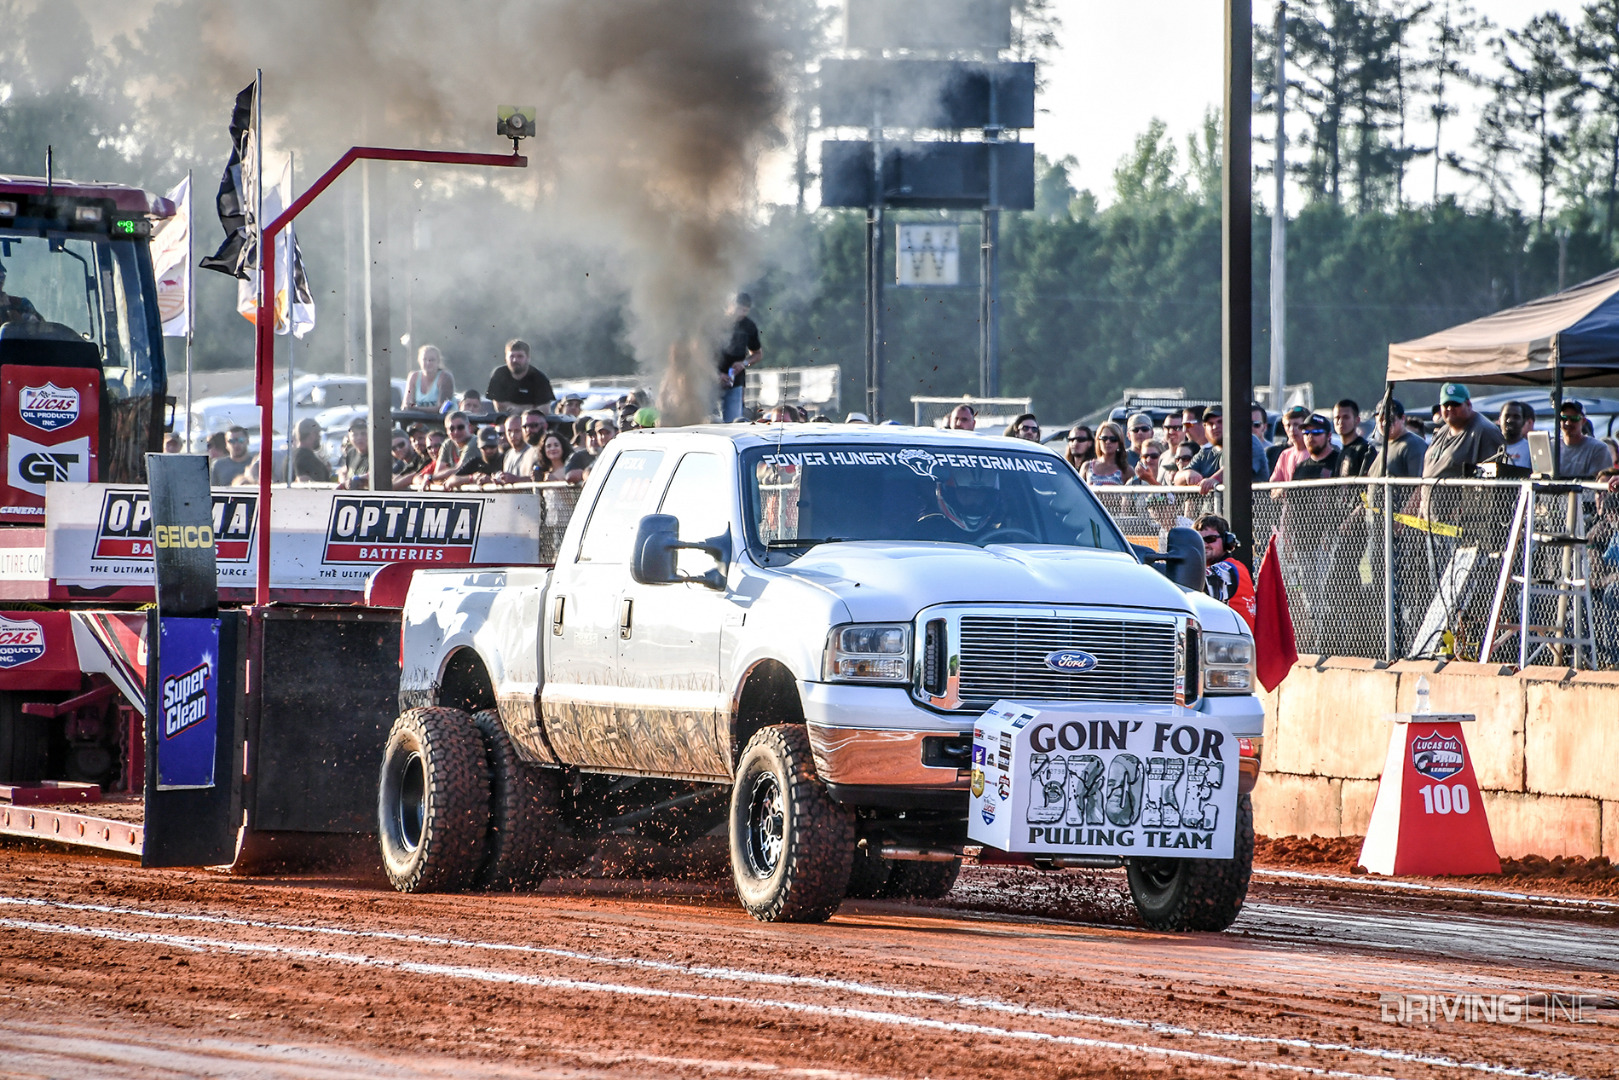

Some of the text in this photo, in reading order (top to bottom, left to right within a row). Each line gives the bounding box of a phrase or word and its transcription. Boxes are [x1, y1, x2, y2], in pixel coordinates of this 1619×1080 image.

[27, 398, 75, 410] LUCAS
[18, 453, 79, 484] GT
[762, 452, 1058, 475] POWER HUNGRY PERFORMANCE
[108, 499, 247, 535] OPMA
[336, 505, 472, 540] OPTIMA
[155, 525, 214, 549] GEICO
[359, 547, 444, 561] BATTERIES
[90, 565, 156, 574] THE ULTIMAT
[215, 568, 248, 576] OURCE
[319, 569, 371, 579] THE ULTIM
[0, 632, 38, 644] CAS
[1058, 654, 1087, 668] Ford
[164, 667, 208, 707] Super
[166, 694, 207, 737] Clean
[1154, 722, 1225, 761] FOR
[1417, 741, 1457, 750] LUCAS OIL
[1432, 754, 1457, 763] PRO
[1026, 753, 1226, 831] BROKE
[1419, 783, 1470, 815] 100
[1028, 827, 1214, 850] PULLING TEAM
